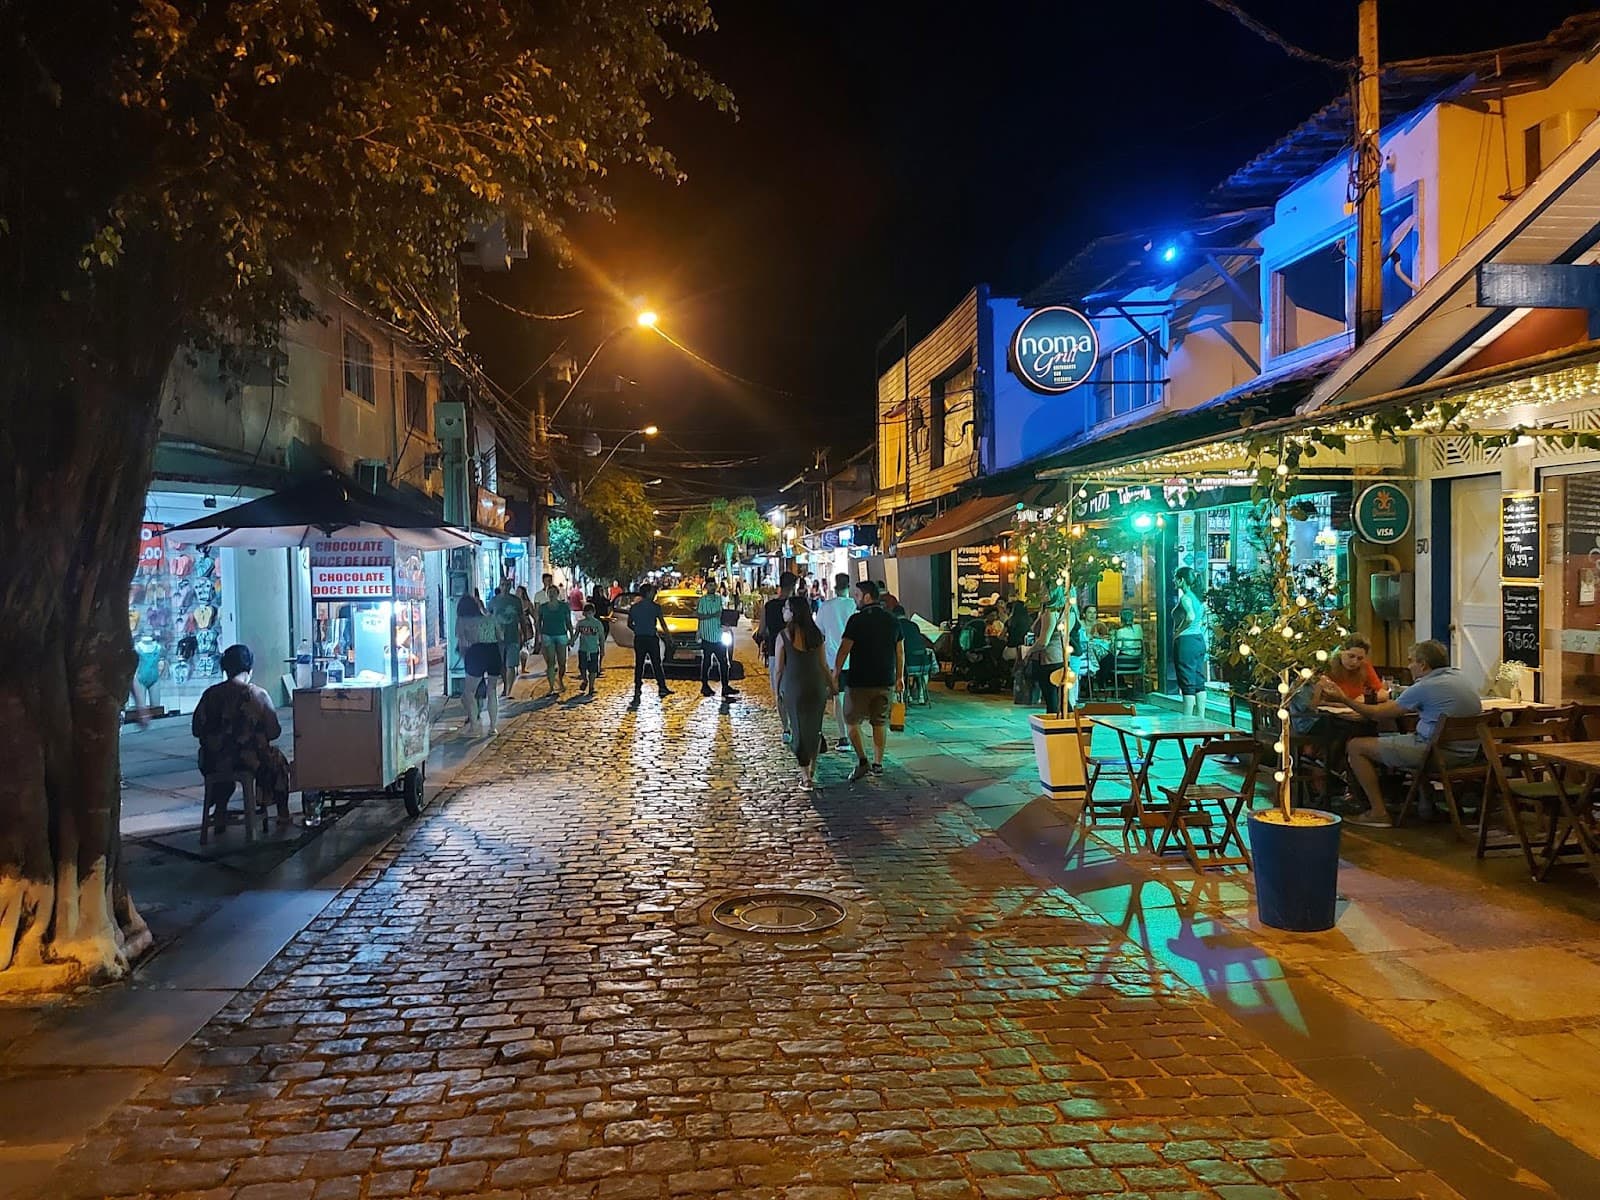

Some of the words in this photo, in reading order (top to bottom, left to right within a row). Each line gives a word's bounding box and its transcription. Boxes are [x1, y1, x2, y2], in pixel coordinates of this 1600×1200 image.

[1021, 335, 1092, 356] noma
[1034, 344, 1080, 378] Grill
[1376, 528, 1394, 536] VISA
[315, 541, 384, 552] CHOCOLATE
[1416, 538, 1429, 554] 50
[344, 556, 359, 566] DE
[360, 556, 392, 566] LEITE
[319, 573, 385, 582] CHOCOLATE
[313, 585, 344, 595] DOCE
[346, 585, 360, 594] DE
[363, 585, 391, 594] LEITE
